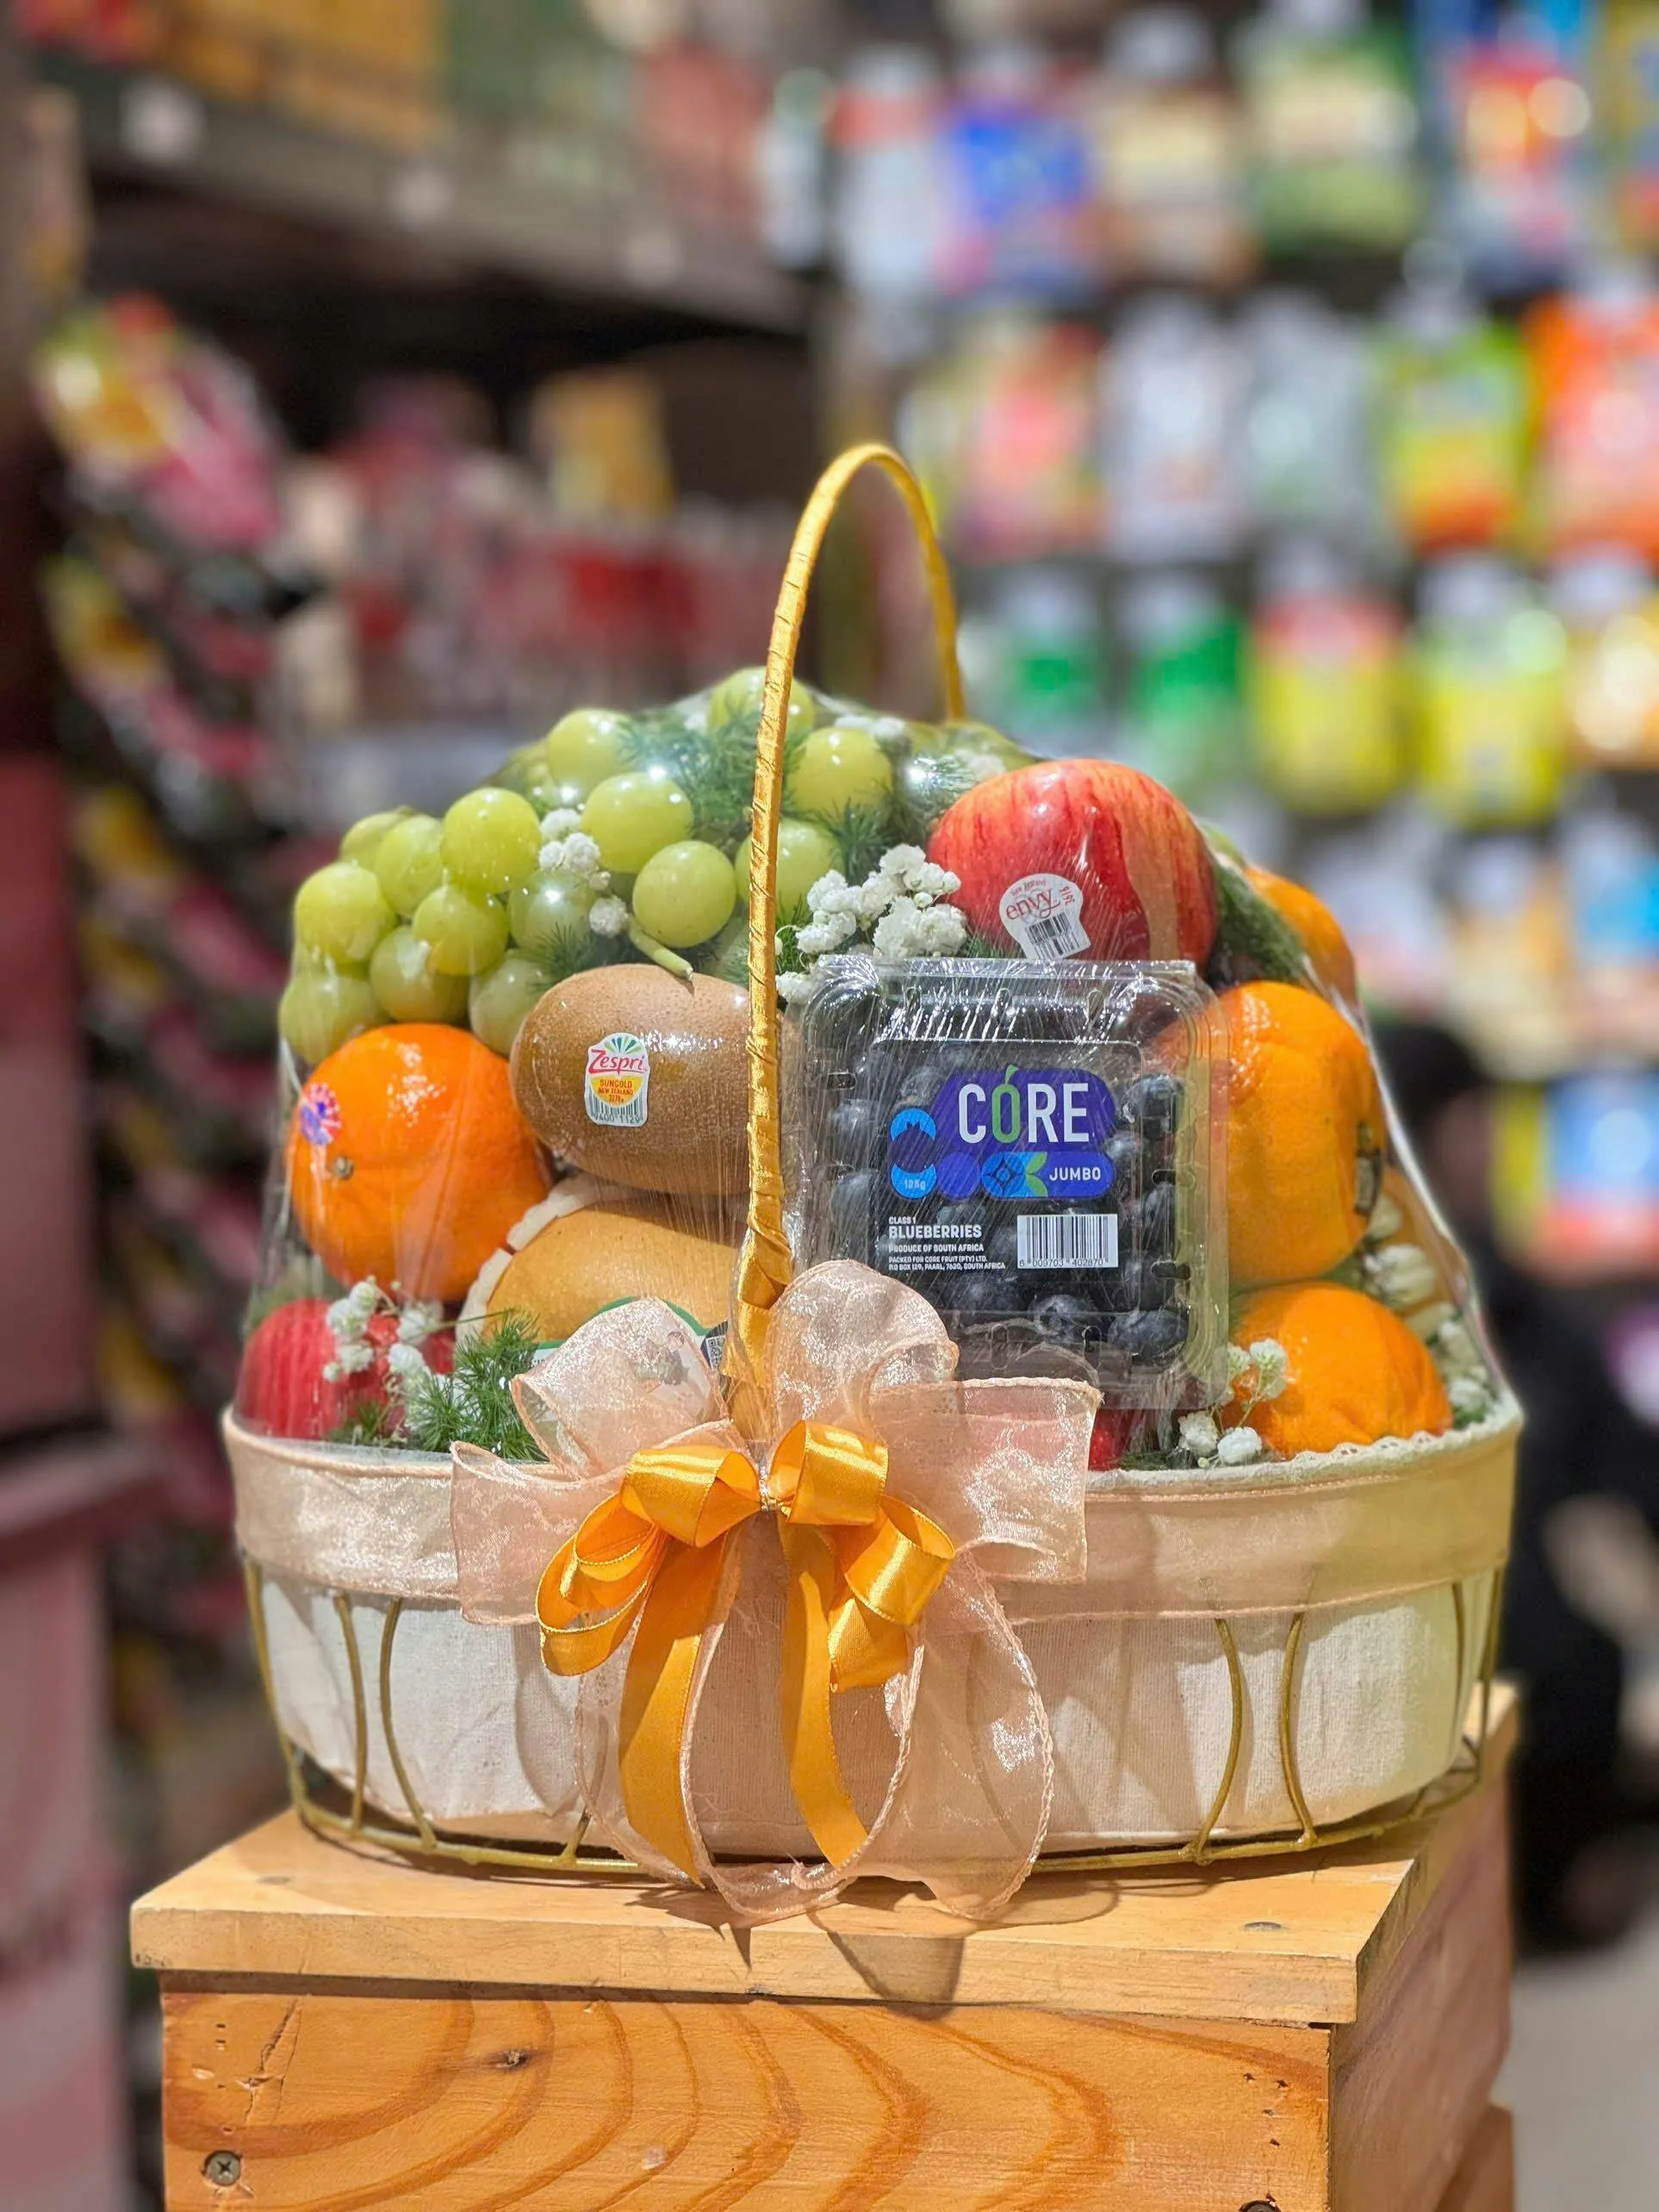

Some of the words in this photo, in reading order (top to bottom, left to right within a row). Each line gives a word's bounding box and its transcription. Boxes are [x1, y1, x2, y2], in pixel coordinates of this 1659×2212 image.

[1006, 888, 1060, 920] envy
[588, 1048, 644, 1075] Zespri
[600, 1078, 632, 1089] SUNGOLD
[1049, 1167, 1101, 1180] JUMBO
[888, 1215, 911, 1224] CLASS
[888, 1224, 982, 1239] BLUEBERRIES
[889, 1244, 922, 1252] PRODUCE
[923, 1244, 932, 1252] OF
[933, 1244, 957, 1252] SOUTH
[958, 1243, 984, 1252] AFRICA
